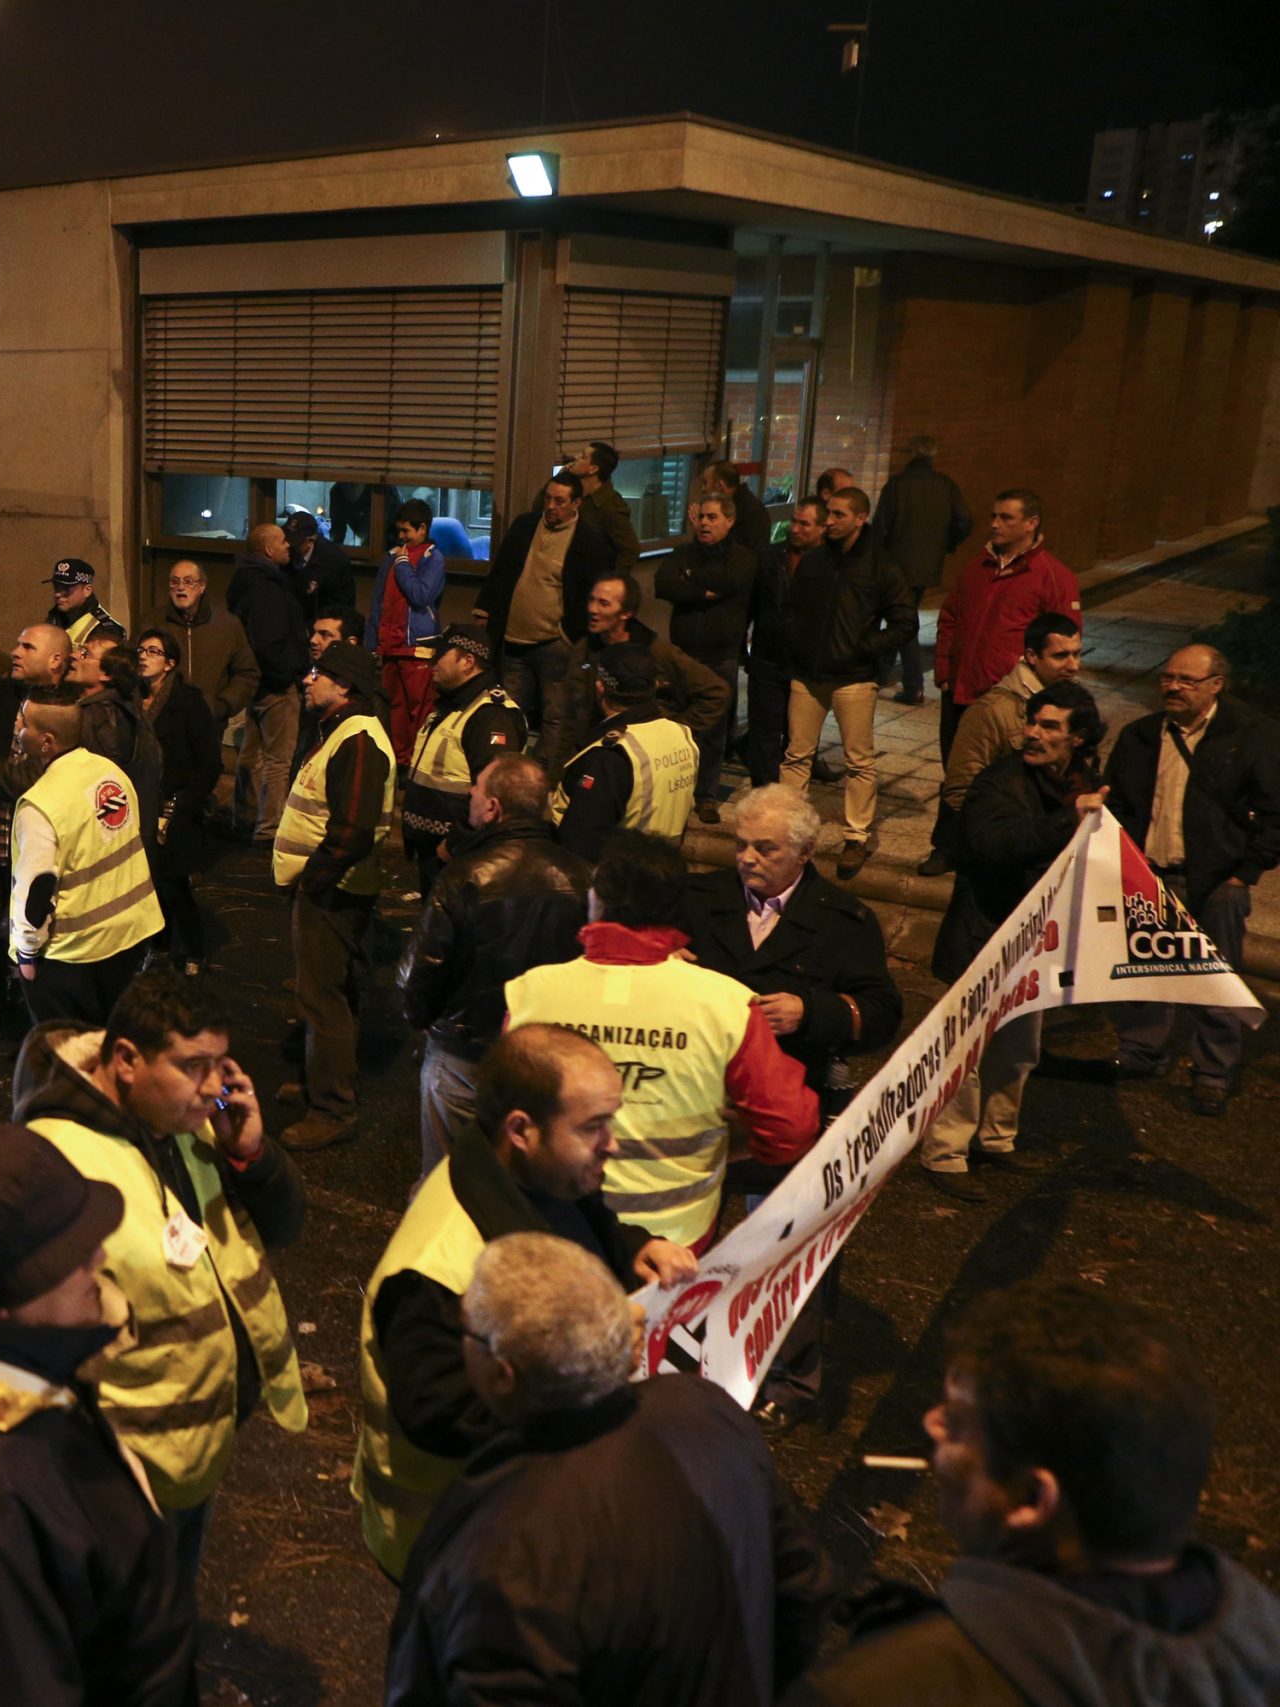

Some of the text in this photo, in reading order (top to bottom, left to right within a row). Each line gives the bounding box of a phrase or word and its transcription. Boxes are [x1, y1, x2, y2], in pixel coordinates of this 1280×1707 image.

[1116, 963, 1187, 975] INTERSINDICAL
[553, 1022, 687, 1051] GANIZAÇÃO
[822, 1157, 844, 1210] Os
[846, 1036, 940, 1183] trabalhadores
